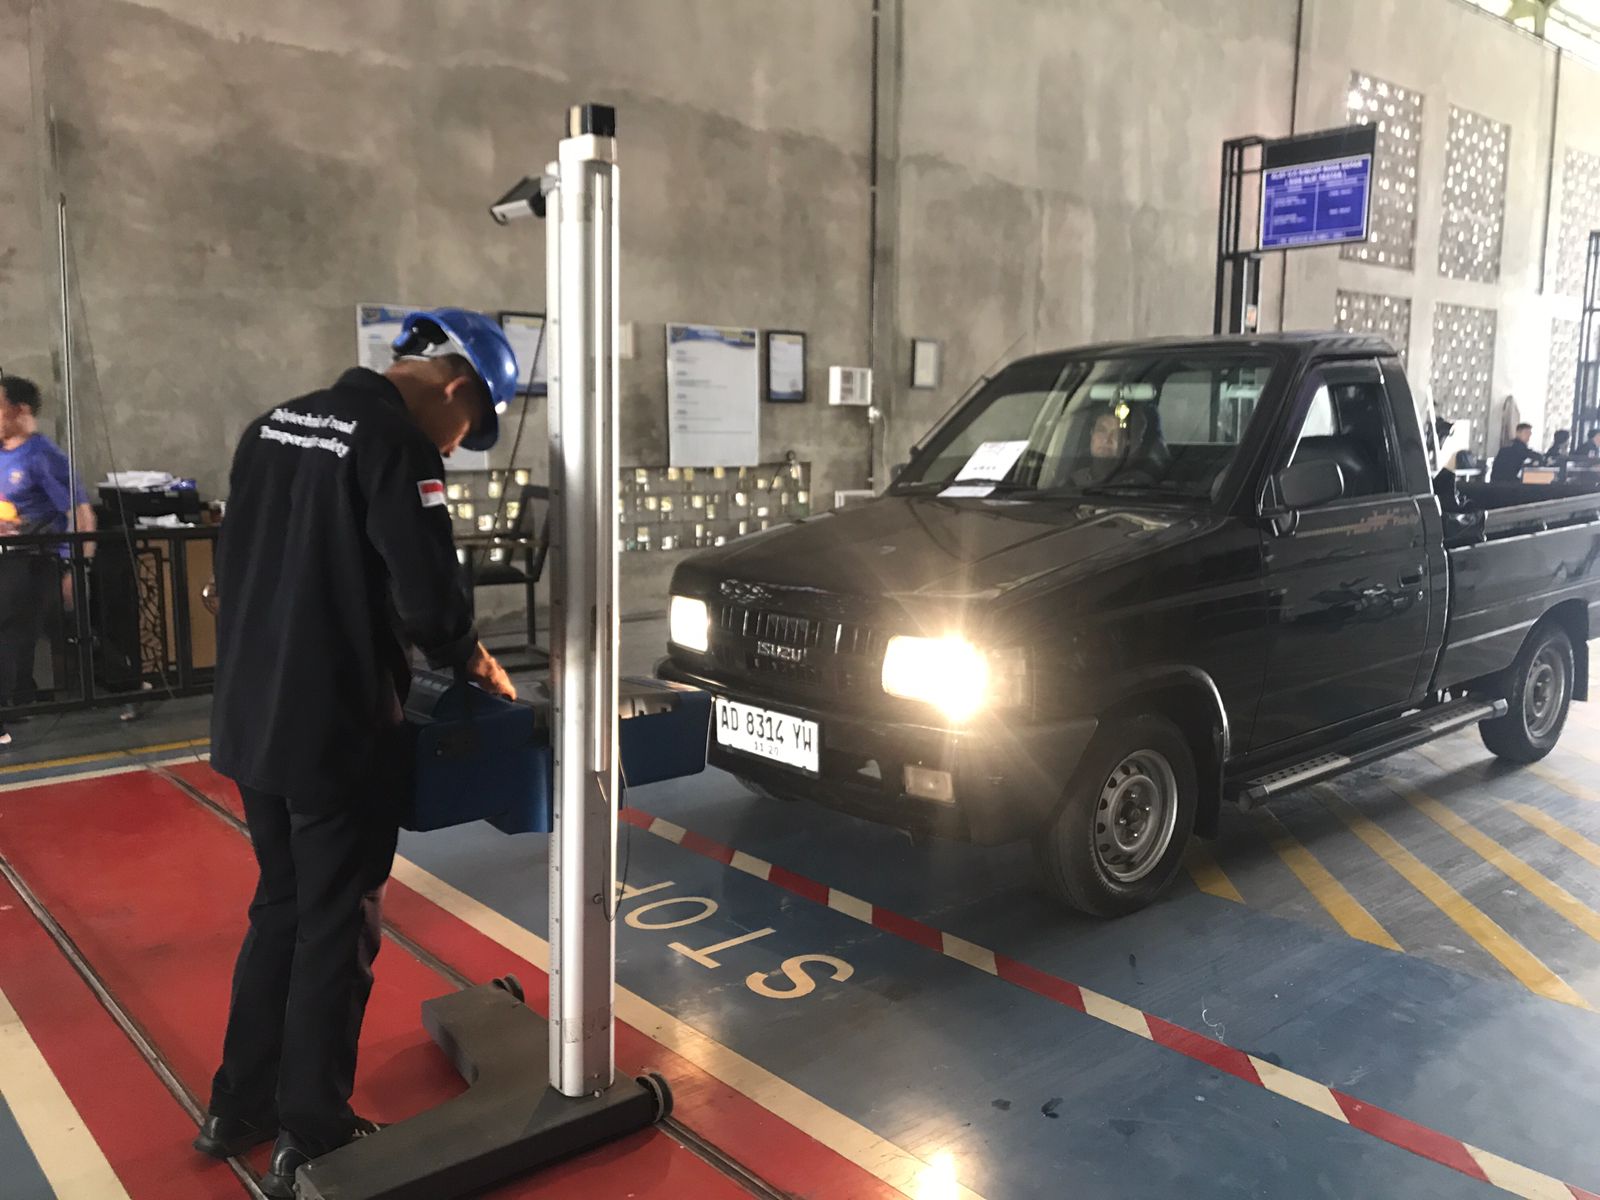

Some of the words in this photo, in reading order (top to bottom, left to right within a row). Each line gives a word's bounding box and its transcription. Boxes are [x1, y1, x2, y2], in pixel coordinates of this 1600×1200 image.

[757, 640, 801, 662] ISUZU
[721, 705, 739, 731] AD
[746, 711, 784, 744] 8314
[792, 723, 812, 752] YW
